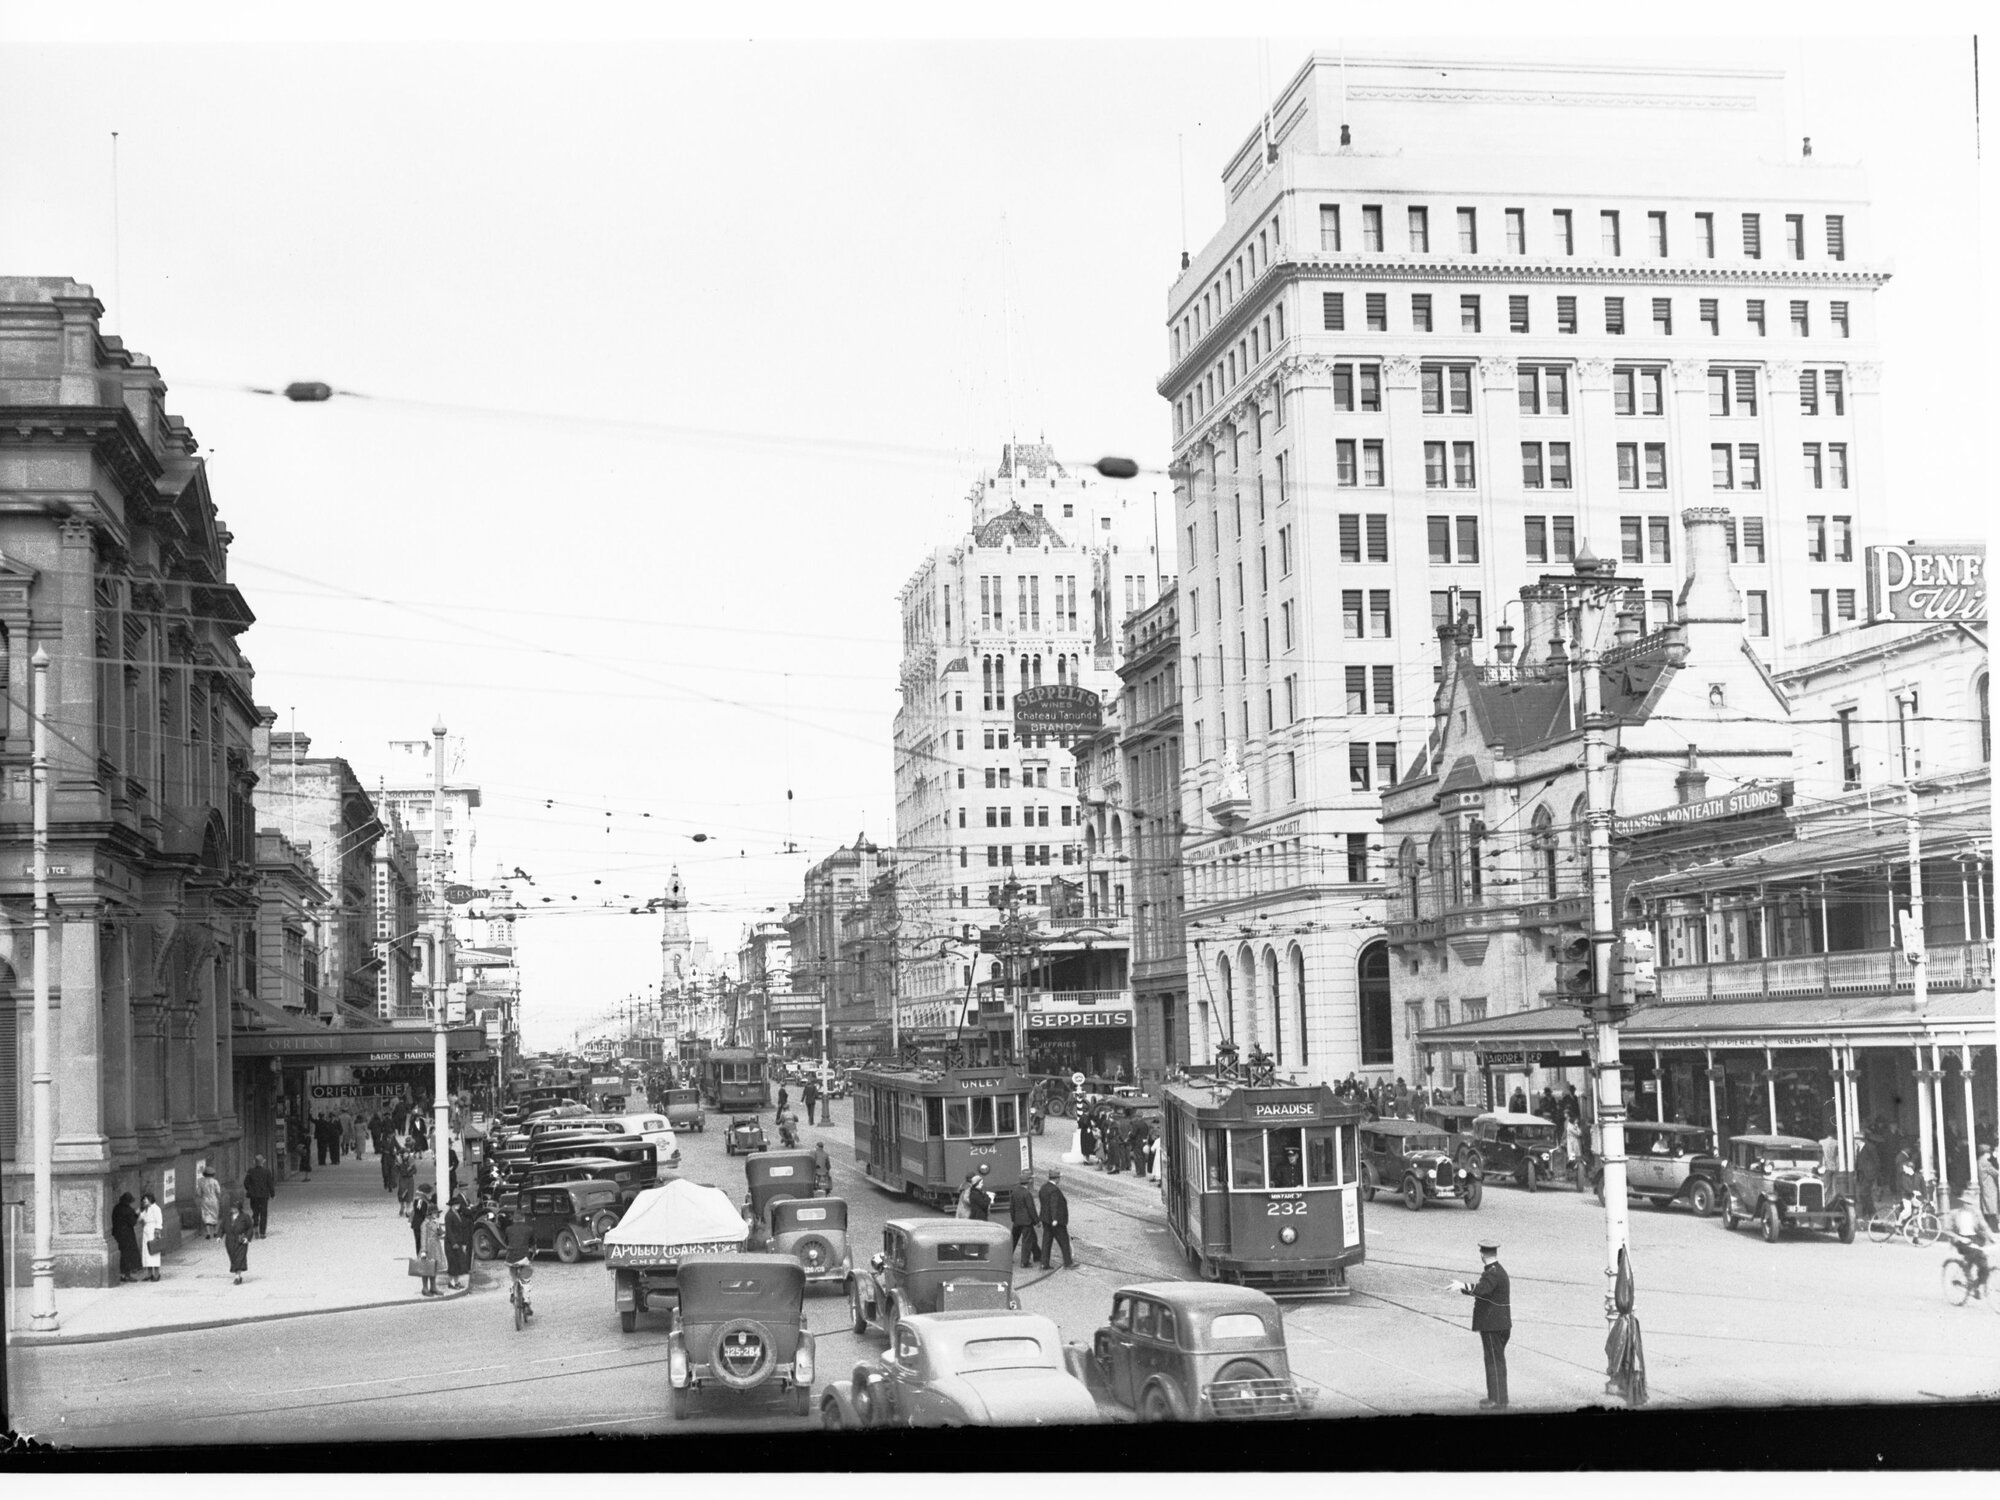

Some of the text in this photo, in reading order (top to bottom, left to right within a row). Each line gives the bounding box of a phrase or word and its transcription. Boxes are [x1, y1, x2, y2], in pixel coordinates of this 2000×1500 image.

[1874, 546, 1986, 620] PENF
[1017, 710, 1097, 720] Chateau Tanunda
[1031, 723, 1082, 732] BRANDY
[1219, 838, 1239, 855] MUTUAL
[1276, 819, 1300, 838] SOCIETY
[1031, 1012, 1127, 1027] SEPPELTS
[269, 1036, 424, 1050] ORIENT LIN
[1664, 1039, 1697, 1047] HOTEL
[404, 1051, 435, 1060] HAIRDR
[313, 1084, 402, 1098] ORIENT LINE
[961, 1080, 1001, 1089] UNLEY
[1256, 1103, 1315, 1115] PARADISE
[970, 1146, 997, 1156] 204
[1267, 1201, 1308, 1215] 232
[611, 1244, 659, 1259] APOLLO
